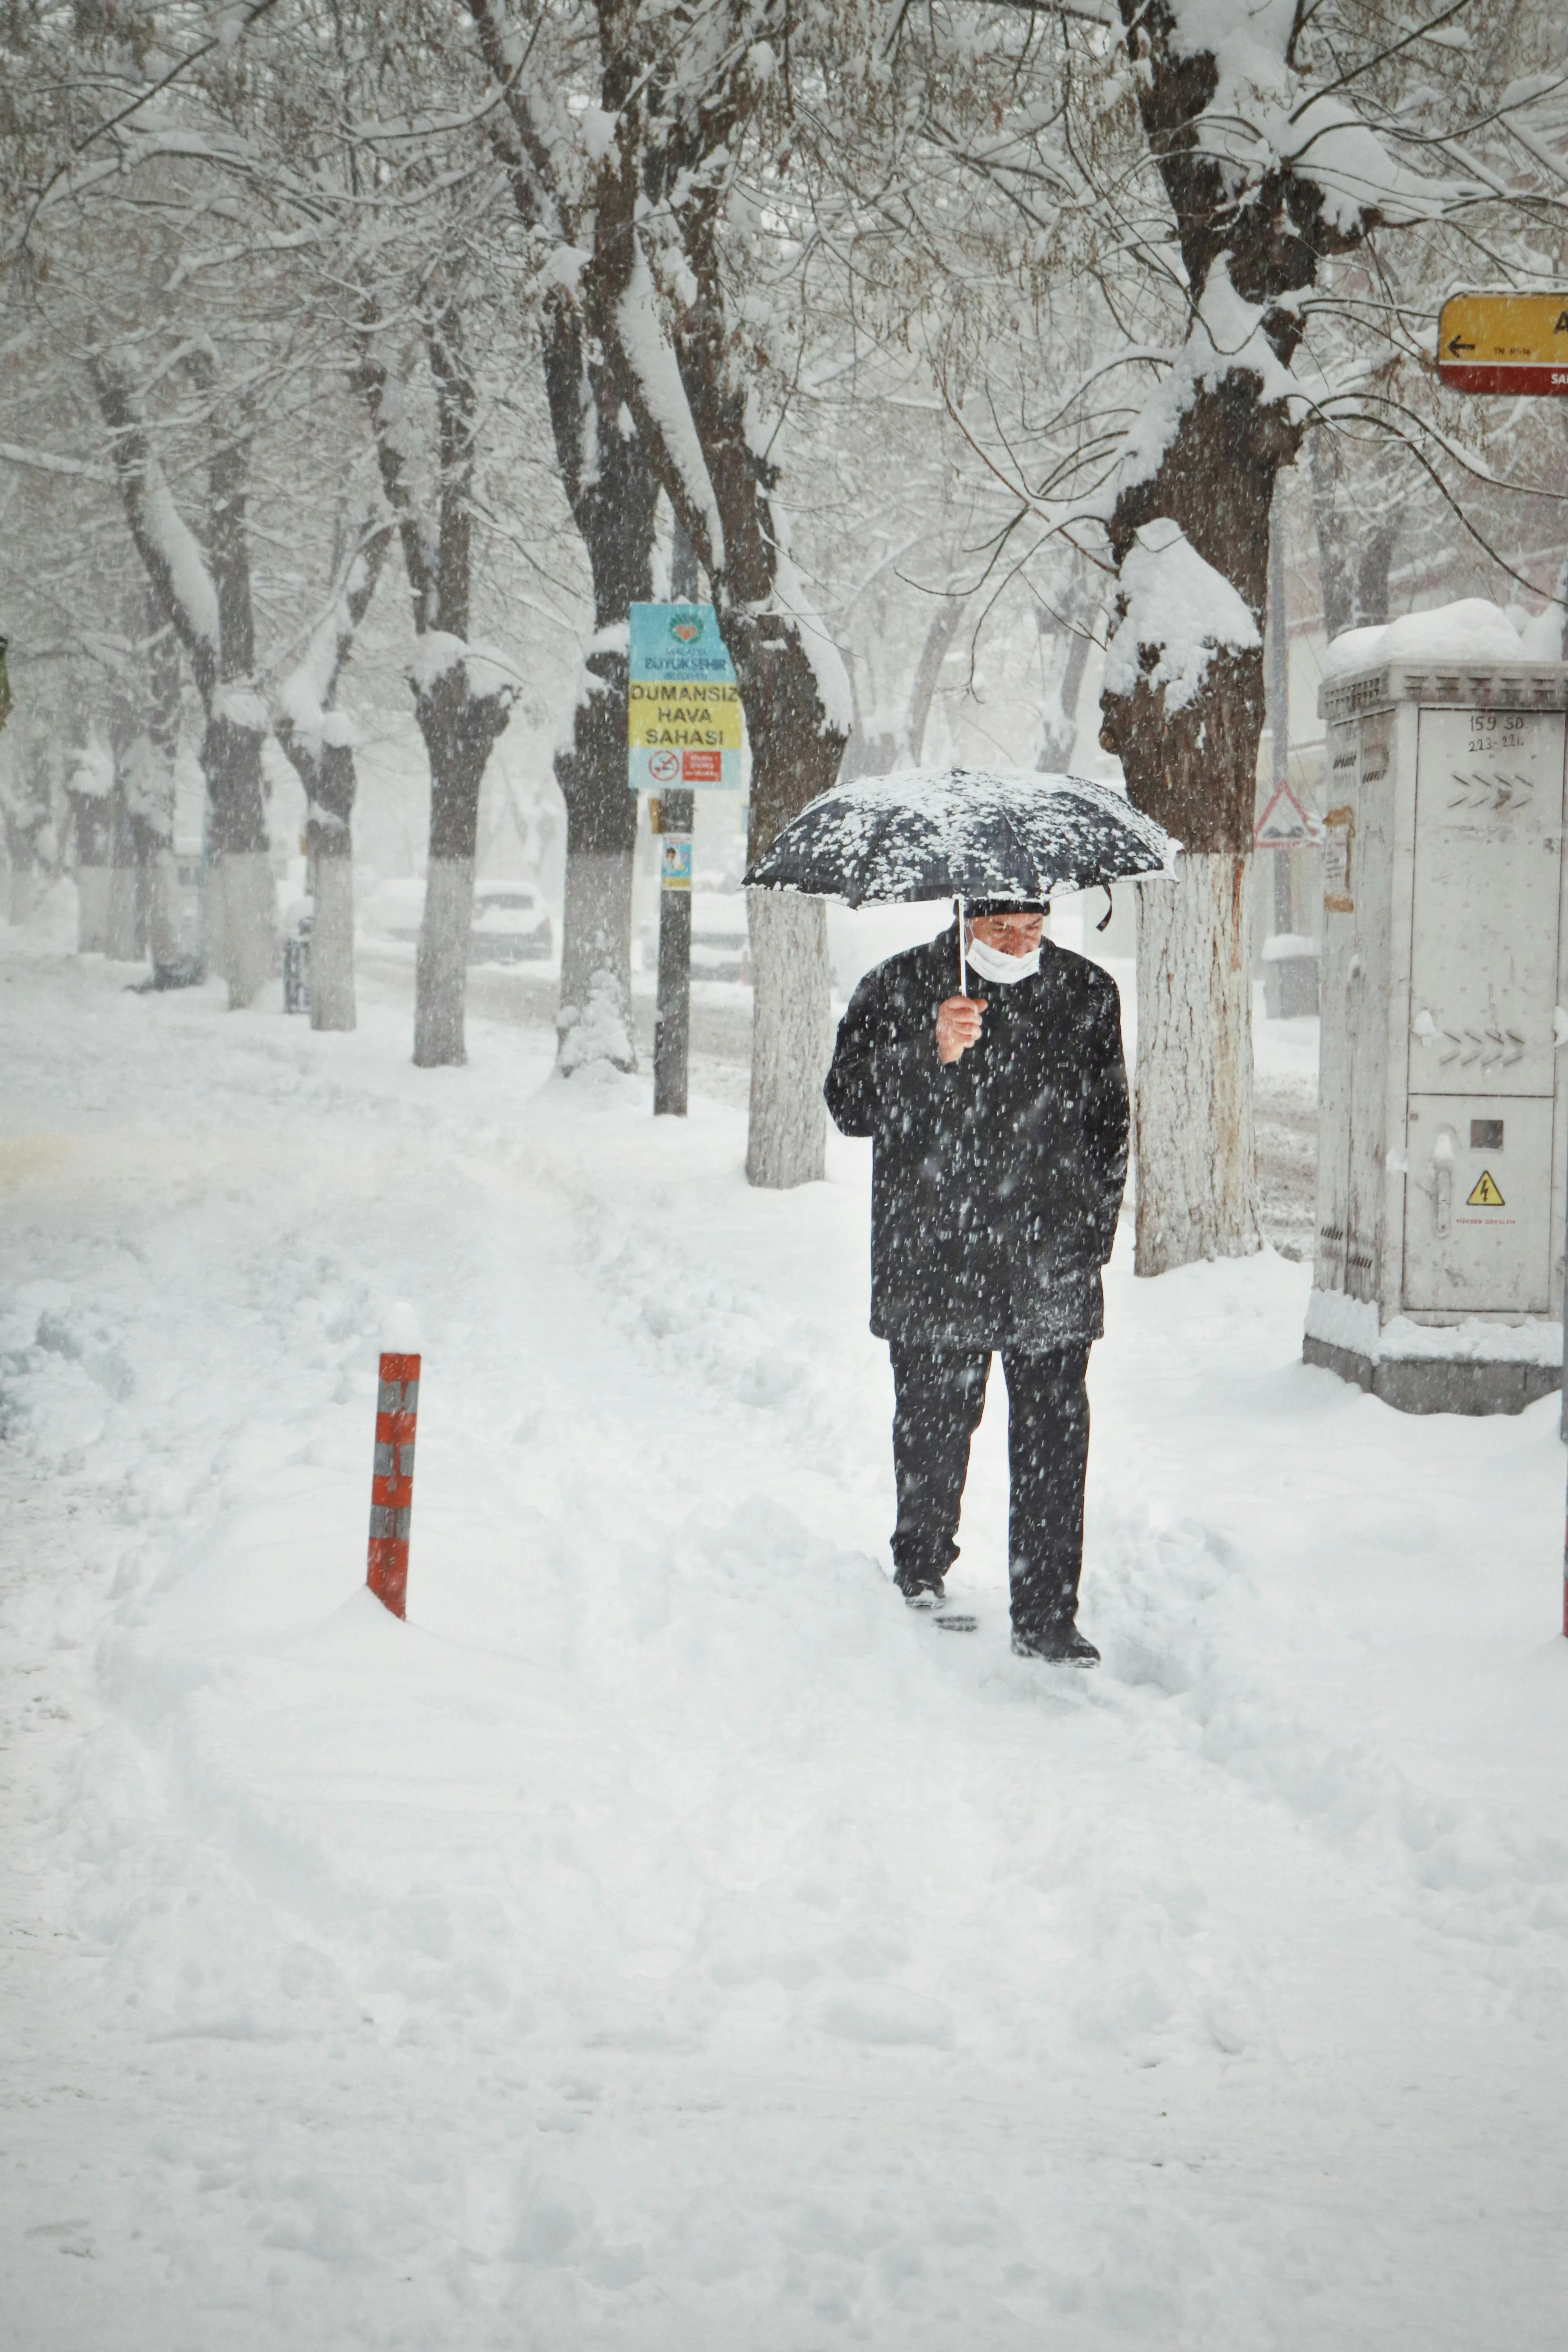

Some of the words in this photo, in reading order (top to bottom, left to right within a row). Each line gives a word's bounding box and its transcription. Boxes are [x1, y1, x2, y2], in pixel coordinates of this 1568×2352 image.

[1551, 373, 1568, 385] SA
[630, 685, 737, 702] DUMANSIZ
[657, 708, 713, 724] HAVA
[1470, 715, 1497, 731] 159
[645, 729, 723, 745] SAHASI
